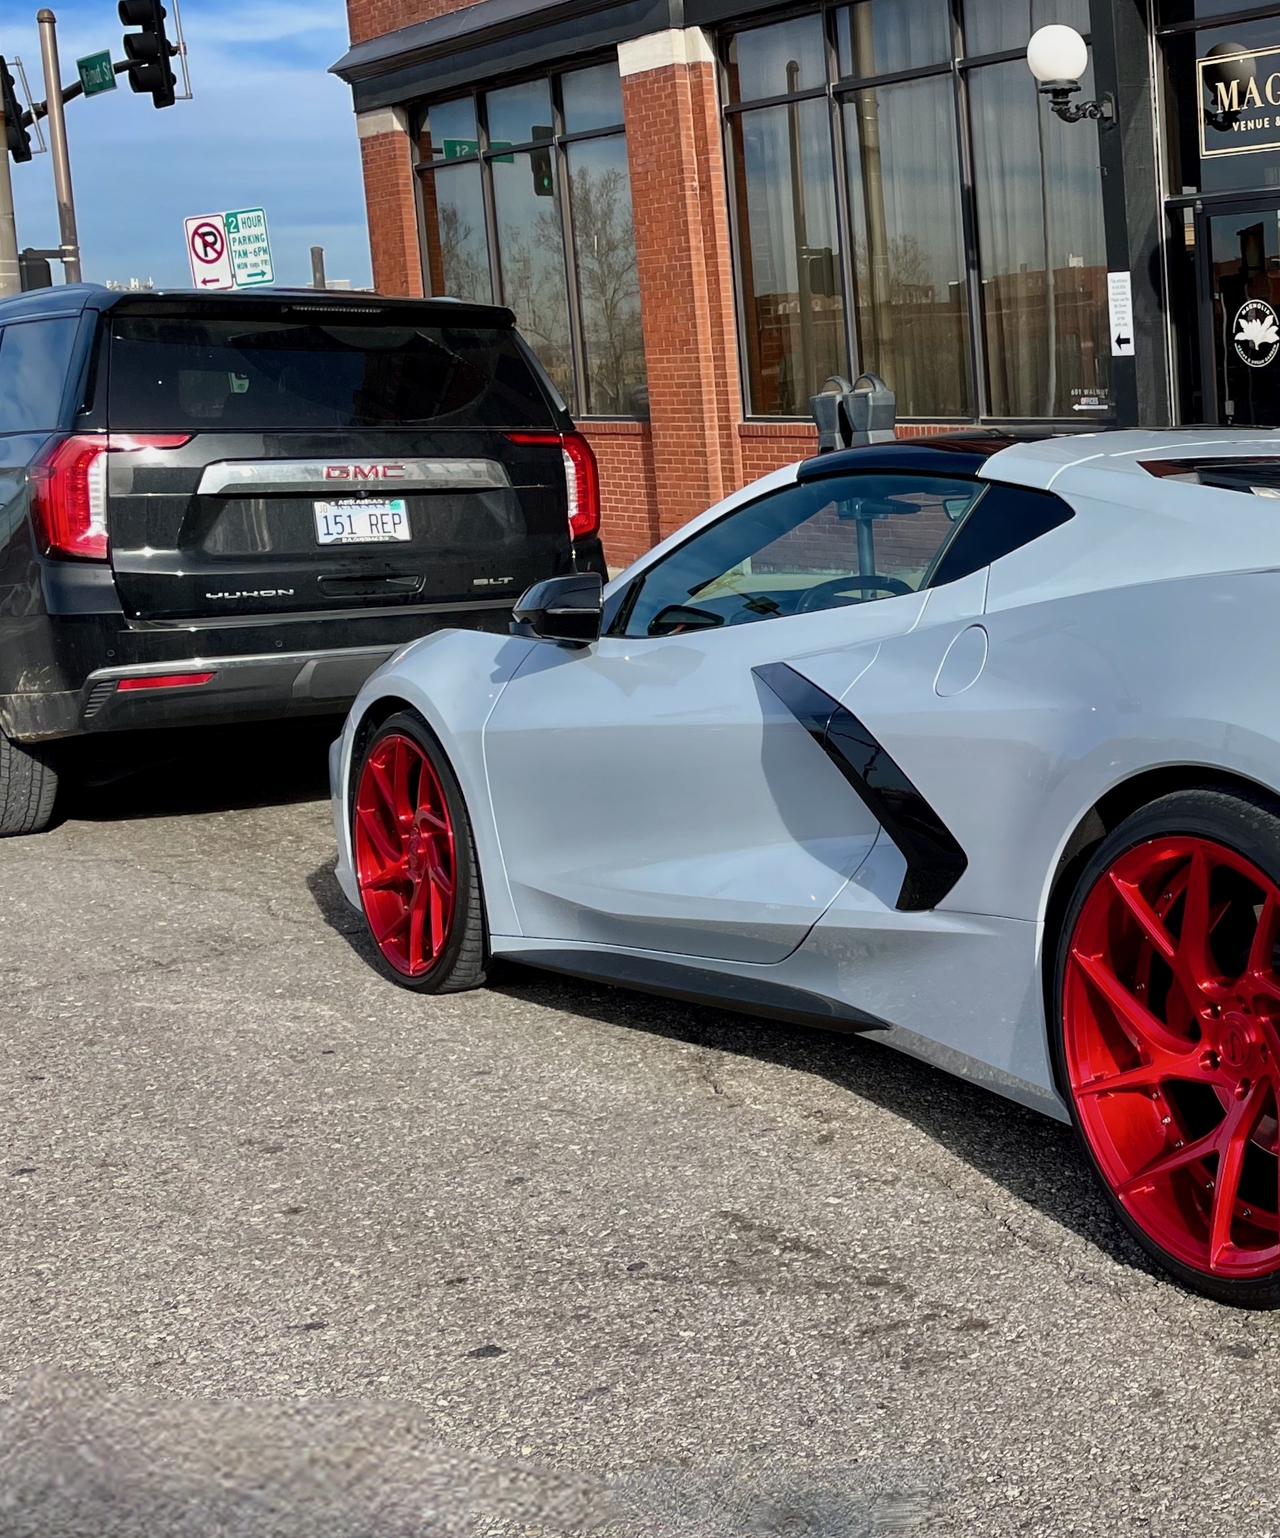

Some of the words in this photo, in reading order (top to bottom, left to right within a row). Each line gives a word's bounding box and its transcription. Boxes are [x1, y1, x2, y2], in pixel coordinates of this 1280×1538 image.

[102, 61, 112, 81] St
[1232, 117, 1270, 131] VENUE
[229, 217, 238, 232] 2
[241, 215, 263, 229] HOUR
[232, 233, 265, 246] PARKING
[233, 246, 269, 259] 7AM-6PM
[1241, 303, 1270, 315] MAGNOLIA
[325, 465, 405, 479] GMC
[323, 514, 357, 536] 151
[368, 513, 402, 534] REP
[206, 588, 294, 599] YUKON
